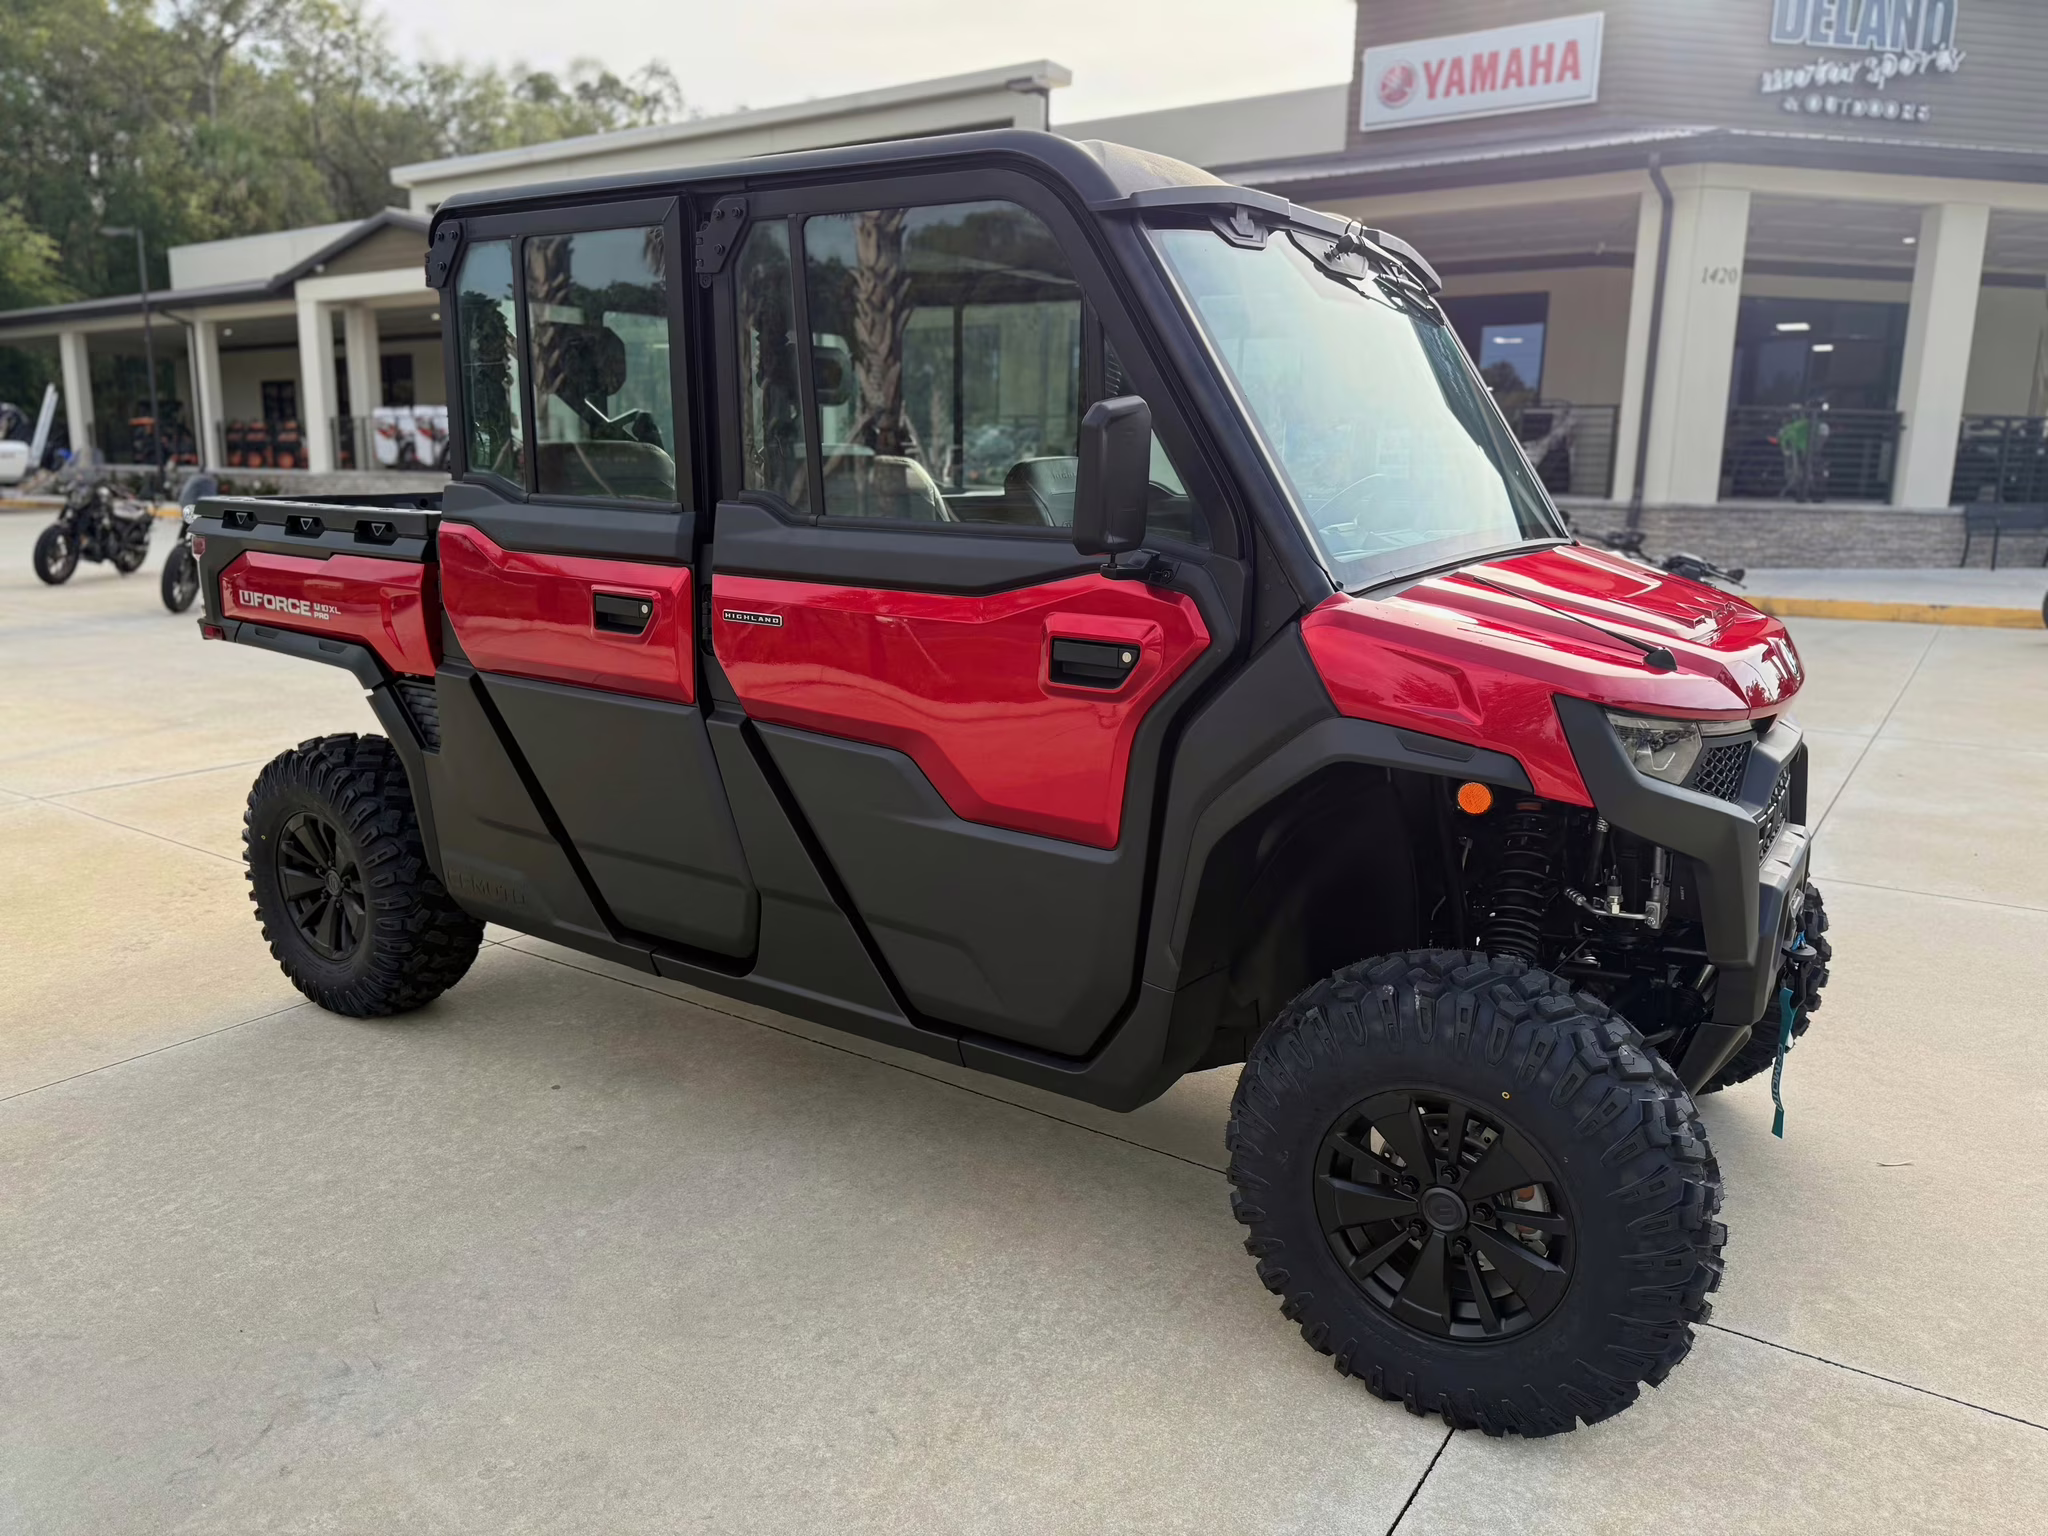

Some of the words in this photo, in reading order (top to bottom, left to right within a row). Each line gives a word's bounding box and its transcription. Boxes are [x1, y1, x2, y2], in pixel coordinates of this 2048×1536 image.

[1423, 39, 1581, 100] YAMAHA
[1804, 93, 1931, 121] OUTDOORS
[1701, 265, 1738, 285] 1420
[239, 589, 312, 617] UFORCE
[313, 611, 330, 620] PRO
[725, 612, 779, 624] HIGHLAND
